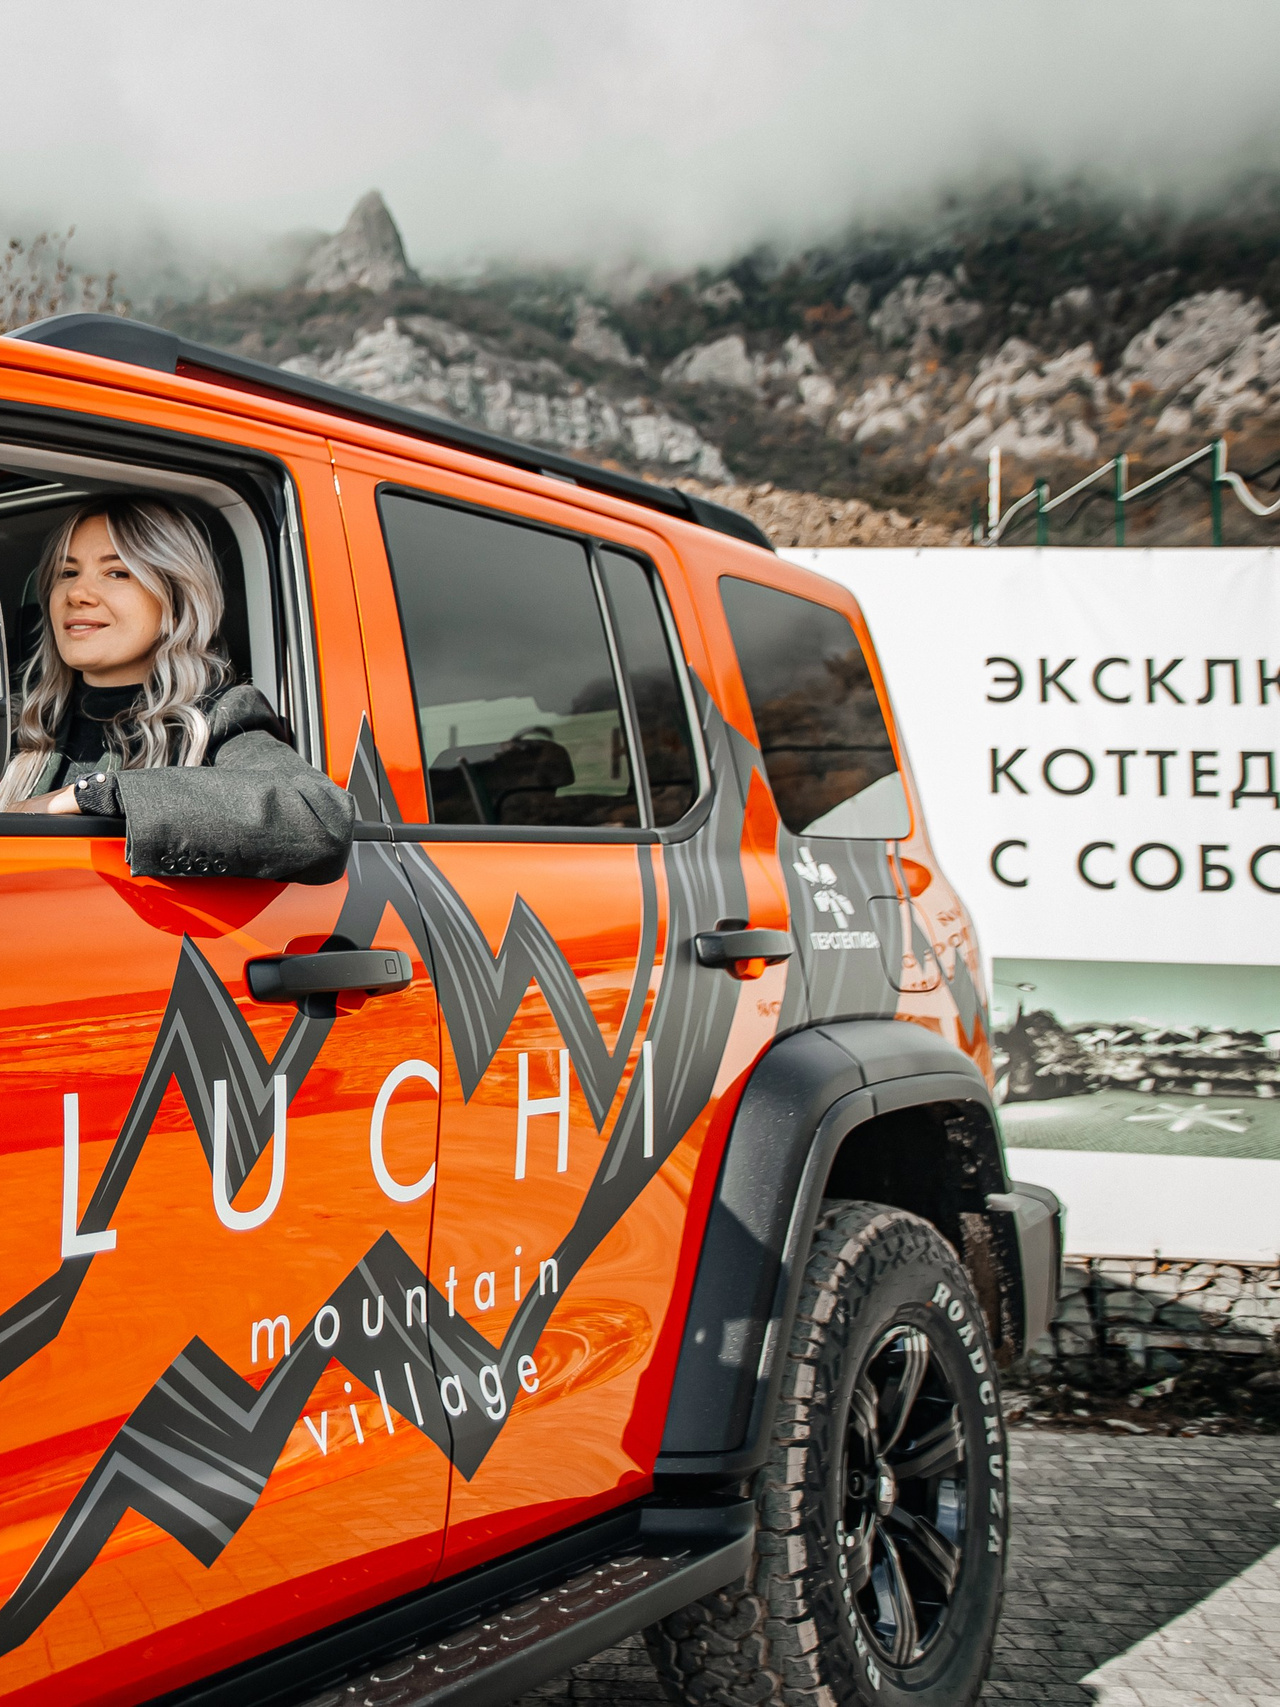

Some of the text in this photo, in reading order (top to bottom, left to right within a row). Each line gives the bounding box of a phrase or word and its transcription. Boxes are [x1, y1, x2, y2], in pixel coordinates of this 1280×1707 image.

[990, 747, 1280, 809] КОТТЕД
[990, 838, 1030, 889] С
[61, 1040, 655, 1258] LUCHI
[251, 1245, 561, 1364] mountain
[303, 1351, 541, 1456] village
